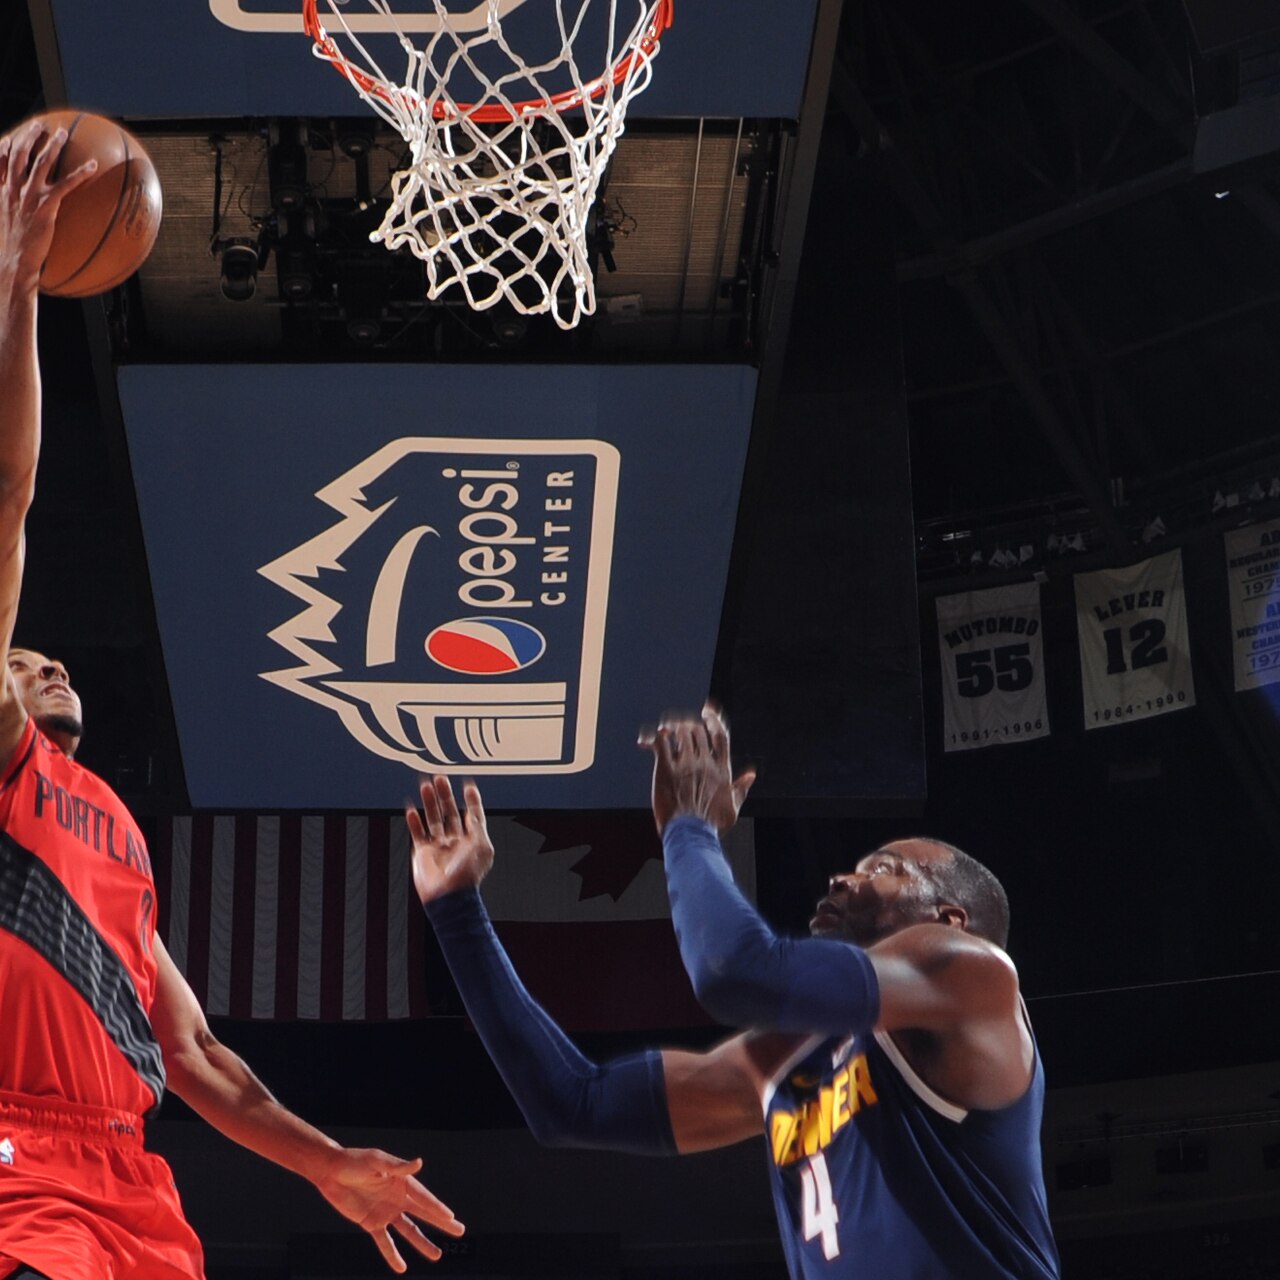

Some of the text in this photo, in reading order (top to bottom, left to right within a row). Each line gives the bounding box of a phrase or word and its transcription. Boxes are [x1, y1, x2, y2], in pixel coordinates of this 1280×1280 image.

[442, 467, 536, 608] pepsi
[540, 470, 574, 606] CENTER
[945, 615, 1039, 649] MUTOMBO
[1094, 589, 1165, 623] LEVER
[955, 643, 1033, 698] 55
[1103, 618, 1168, 676] 12
[951, 718, 1043, 745] 1991-1996
[1093, 691, 1186, 721] 1984-1990
[33, 770, 151, 878] PORTLAN
[801, 1153, 839, 1261] 4
